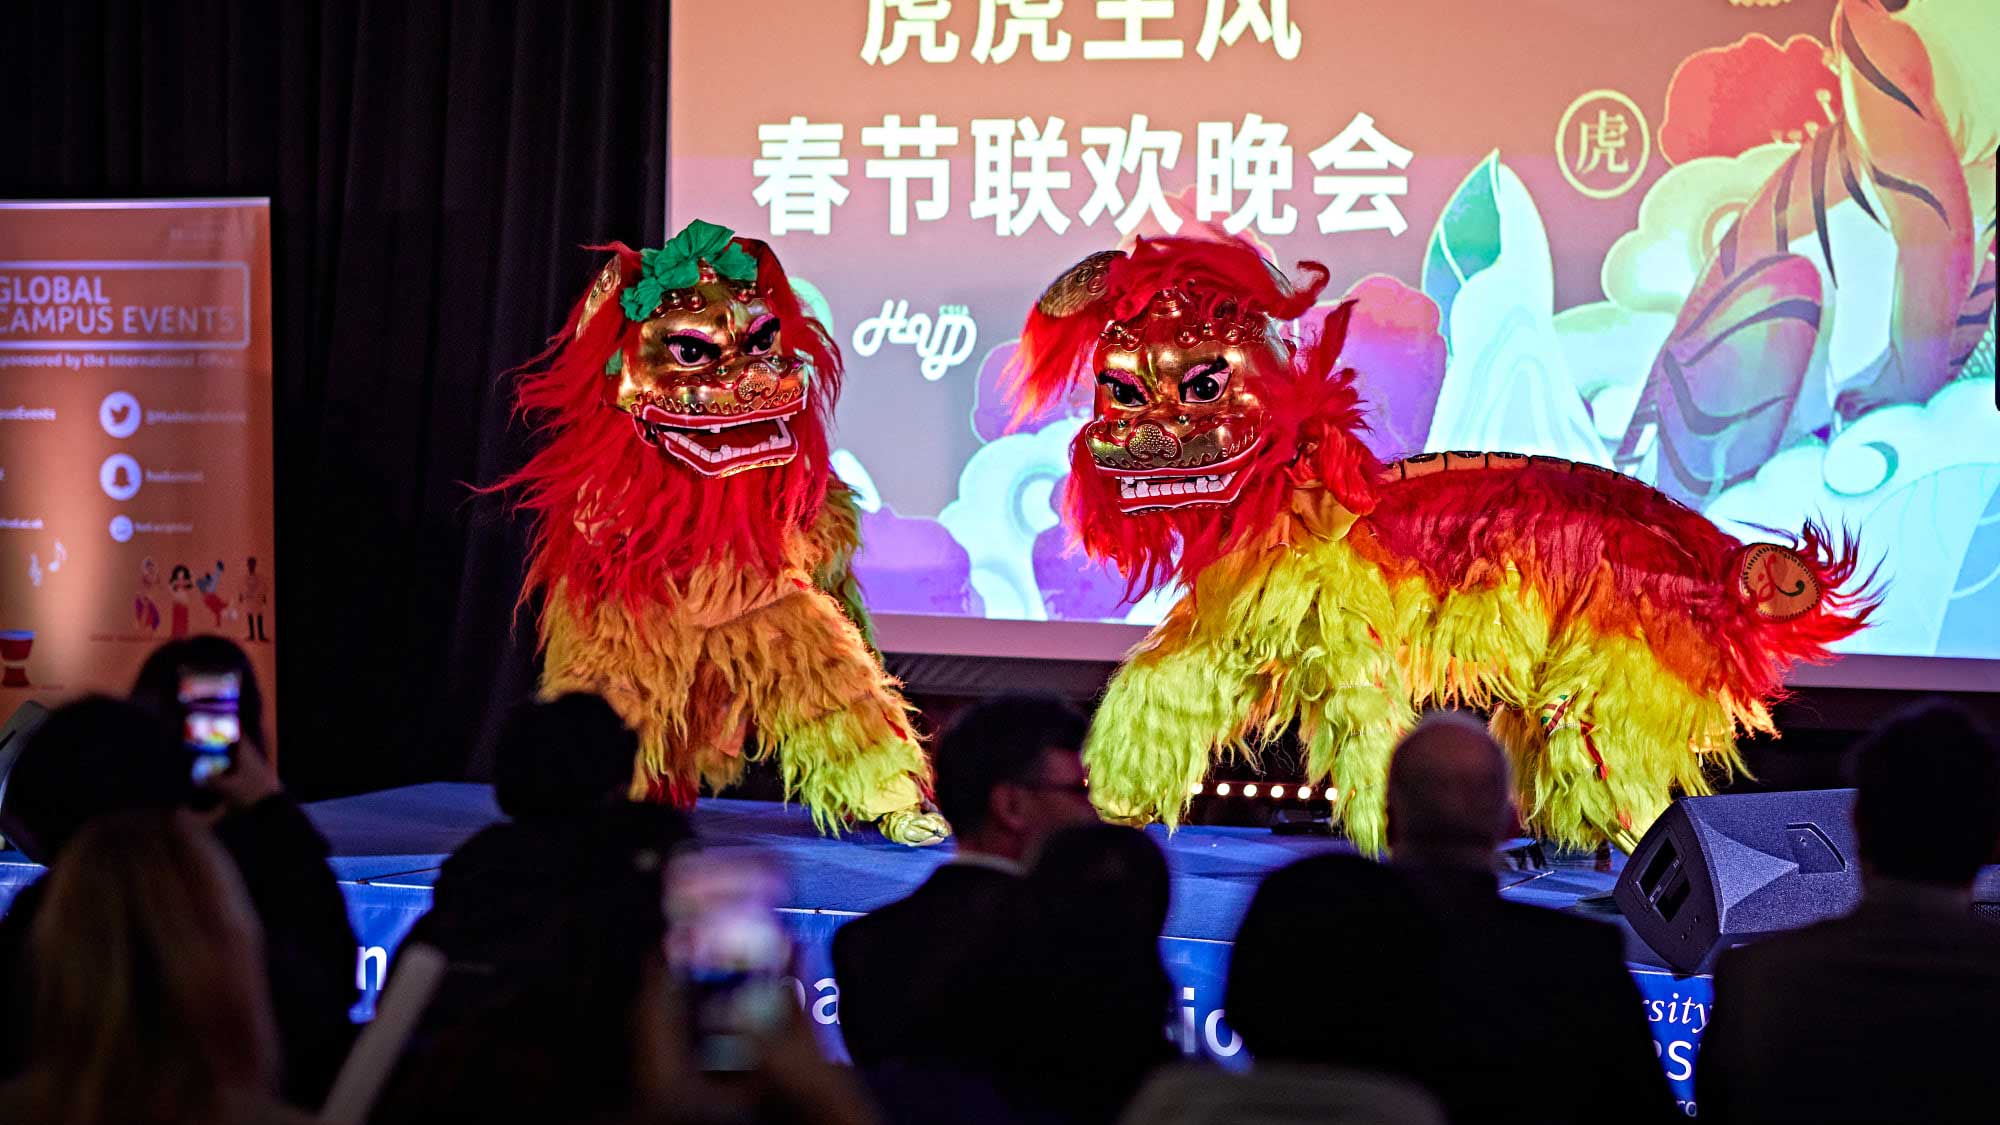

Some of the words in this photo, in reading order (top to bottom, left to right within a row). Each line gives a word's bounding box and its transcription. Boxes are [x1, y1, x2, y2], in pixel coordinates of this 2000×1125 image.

[1576, 109, 1629, 174] 虎
[752, 111, 1414, 237] 春节联欢晚会
[0, 276, 110, 304] GLOBAL
[123, 306, 235, 334] EVENTS
[65, 352, 80, 371] by
